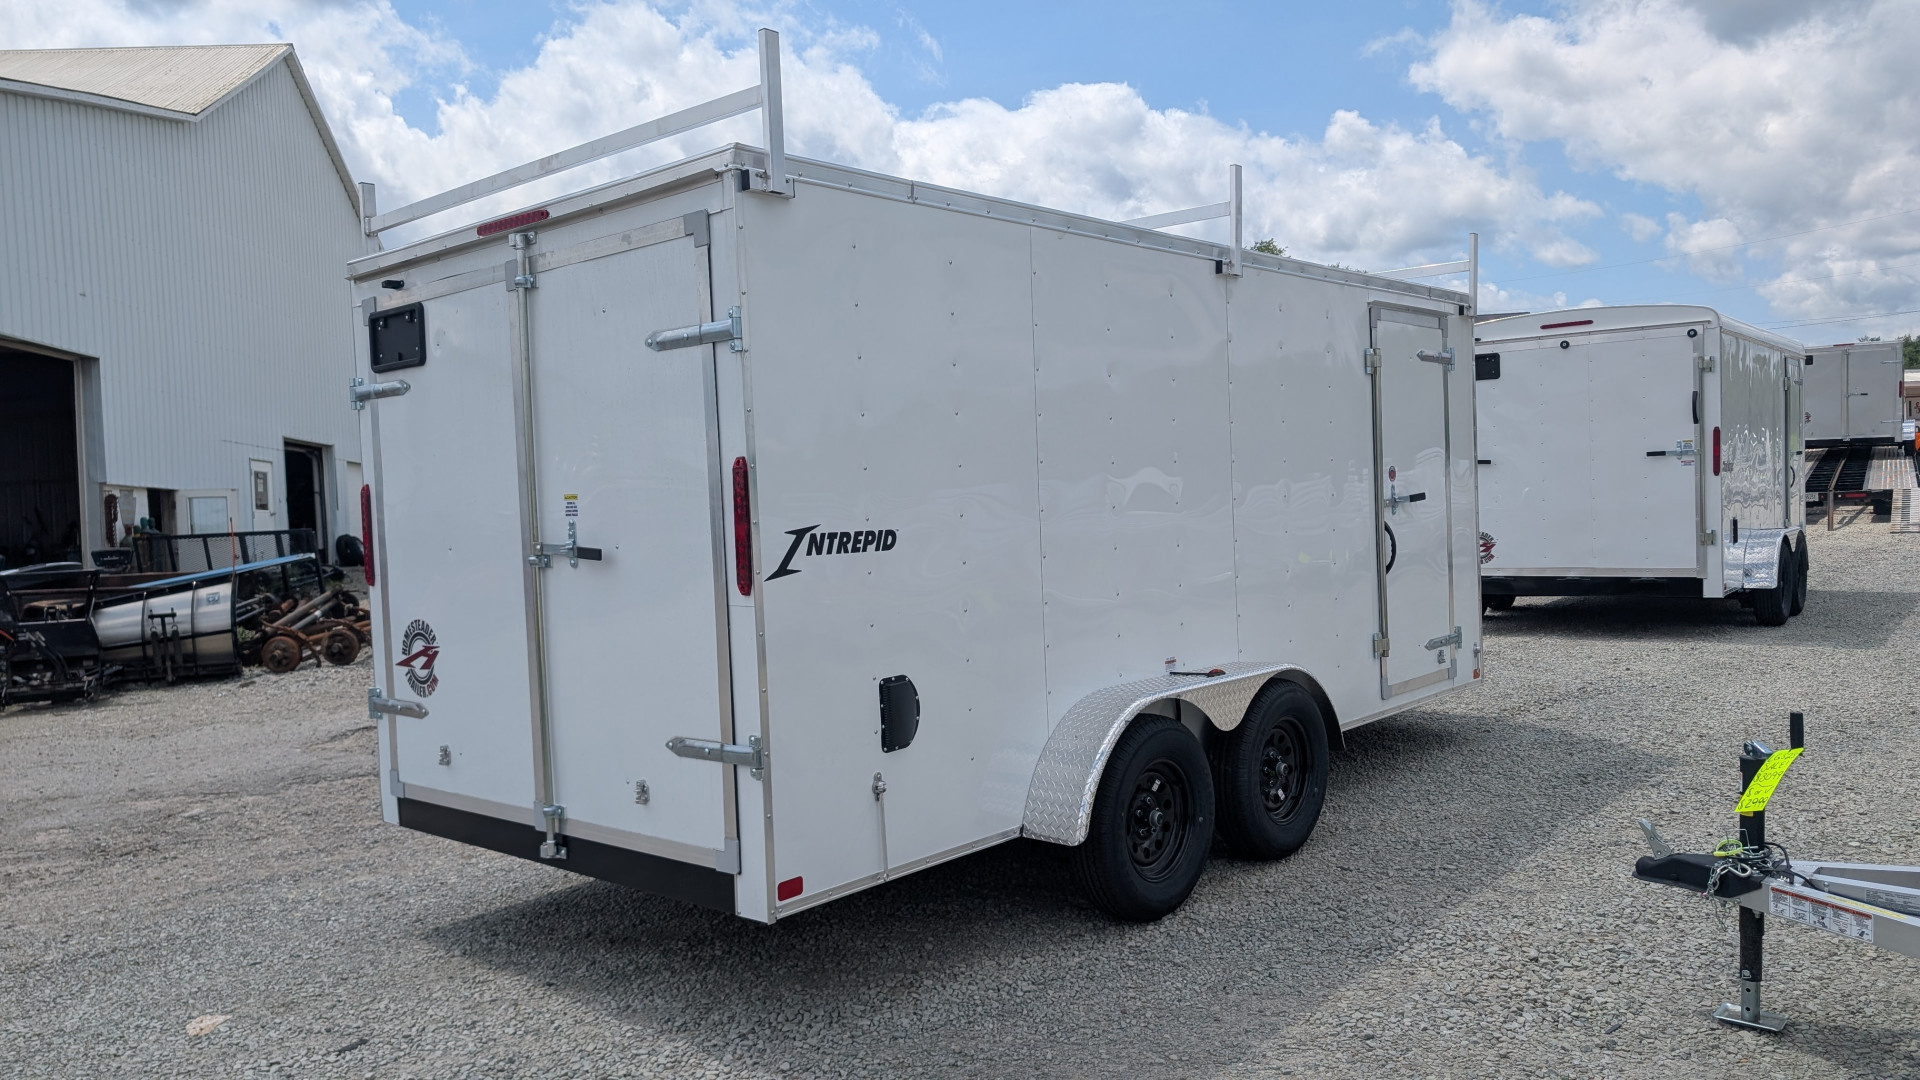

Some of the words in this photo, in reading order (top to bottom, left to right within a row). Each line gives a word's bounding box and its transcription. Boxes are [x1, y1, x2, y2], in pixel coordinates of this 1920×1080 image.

[764, 524, 897, 582] INTREPID
[402, 619, 437, 656] HOMESTEADER
[405, 671, 439, 698] TRAILER.COM
